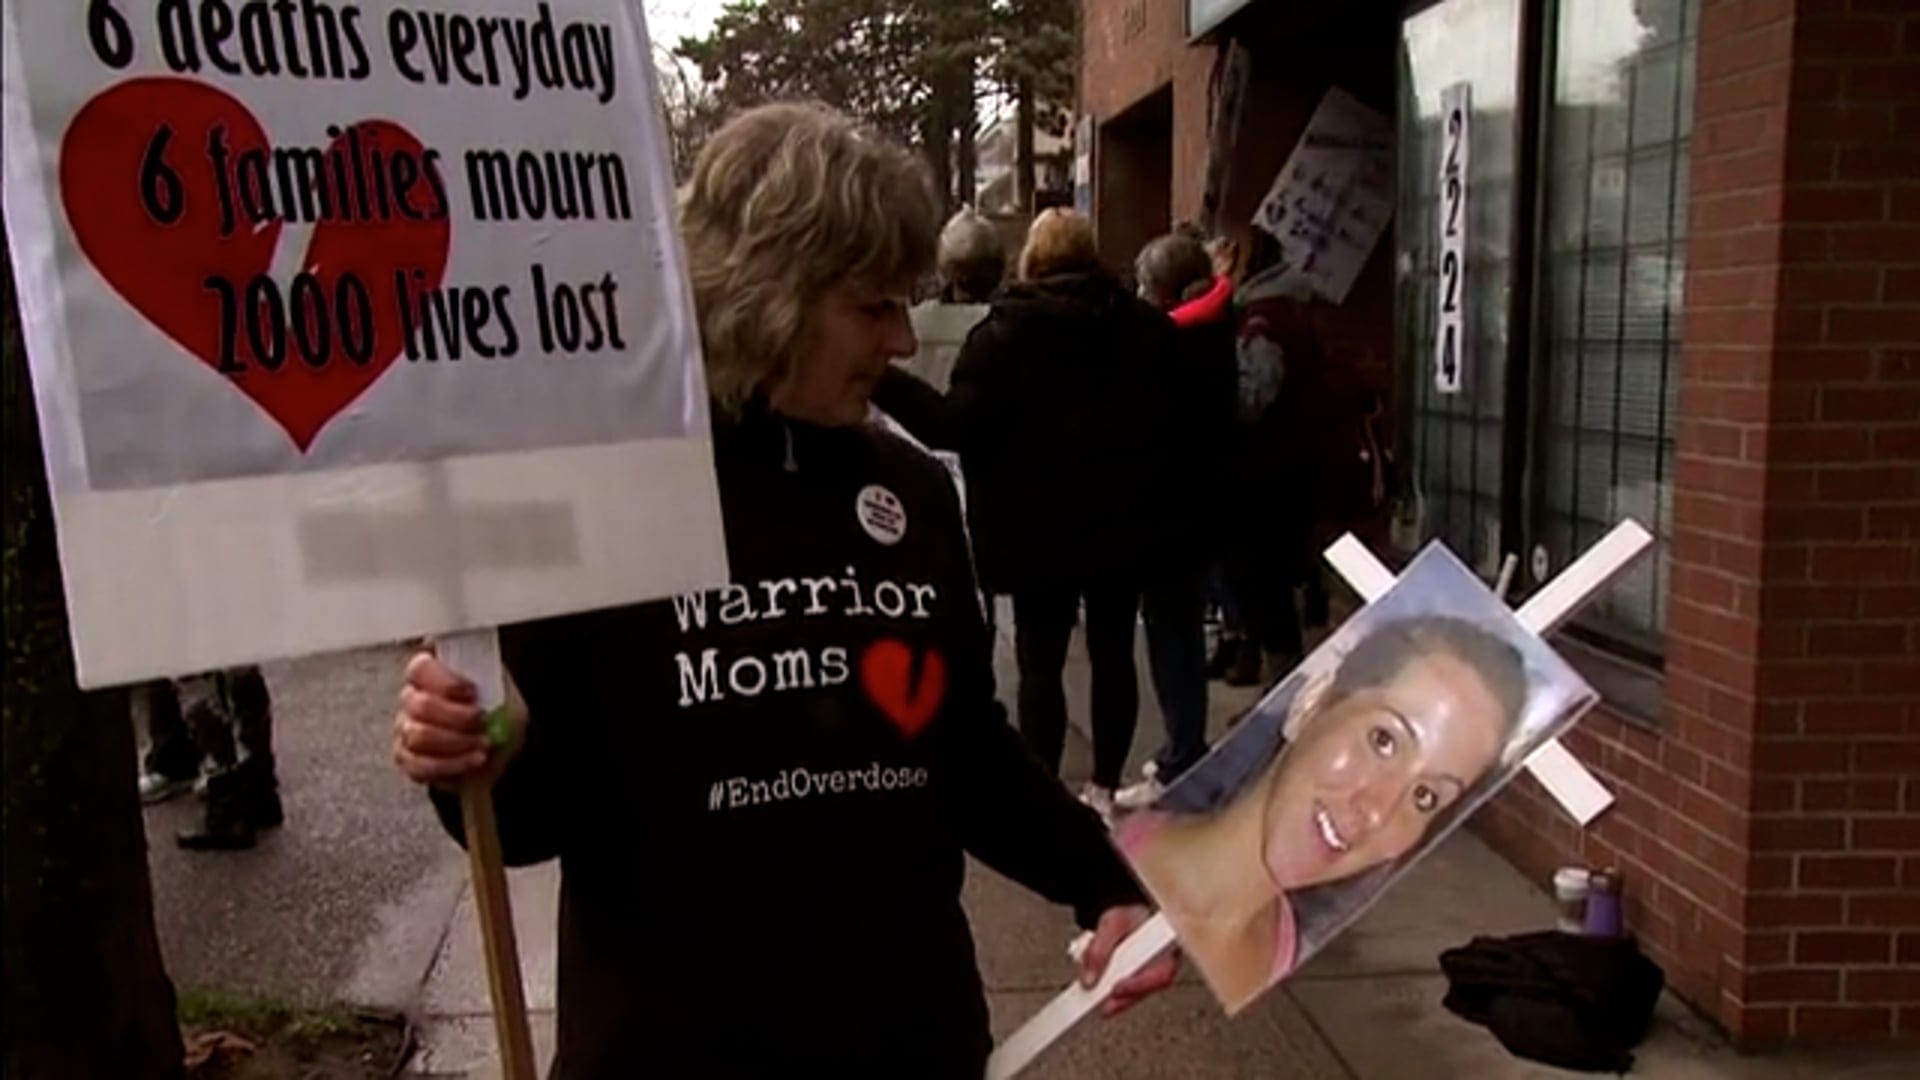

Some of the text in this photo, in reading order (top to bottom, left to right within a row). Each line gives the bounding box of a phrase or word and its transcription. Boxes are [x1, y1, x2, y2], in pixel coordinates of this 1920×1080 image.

[88, 0, 615, 105] 6 deaths everyday
[140, 124, 632, 236] 6 families mourn
[1442, 108, 1463, 385] 2224
[204, 263, 627, 374] 2000 lives lost
[673, 566, 937, 633] Warrior
[674, 648, 850, 707] Moms
[708, 762, 929, 811] #EndOverdose
